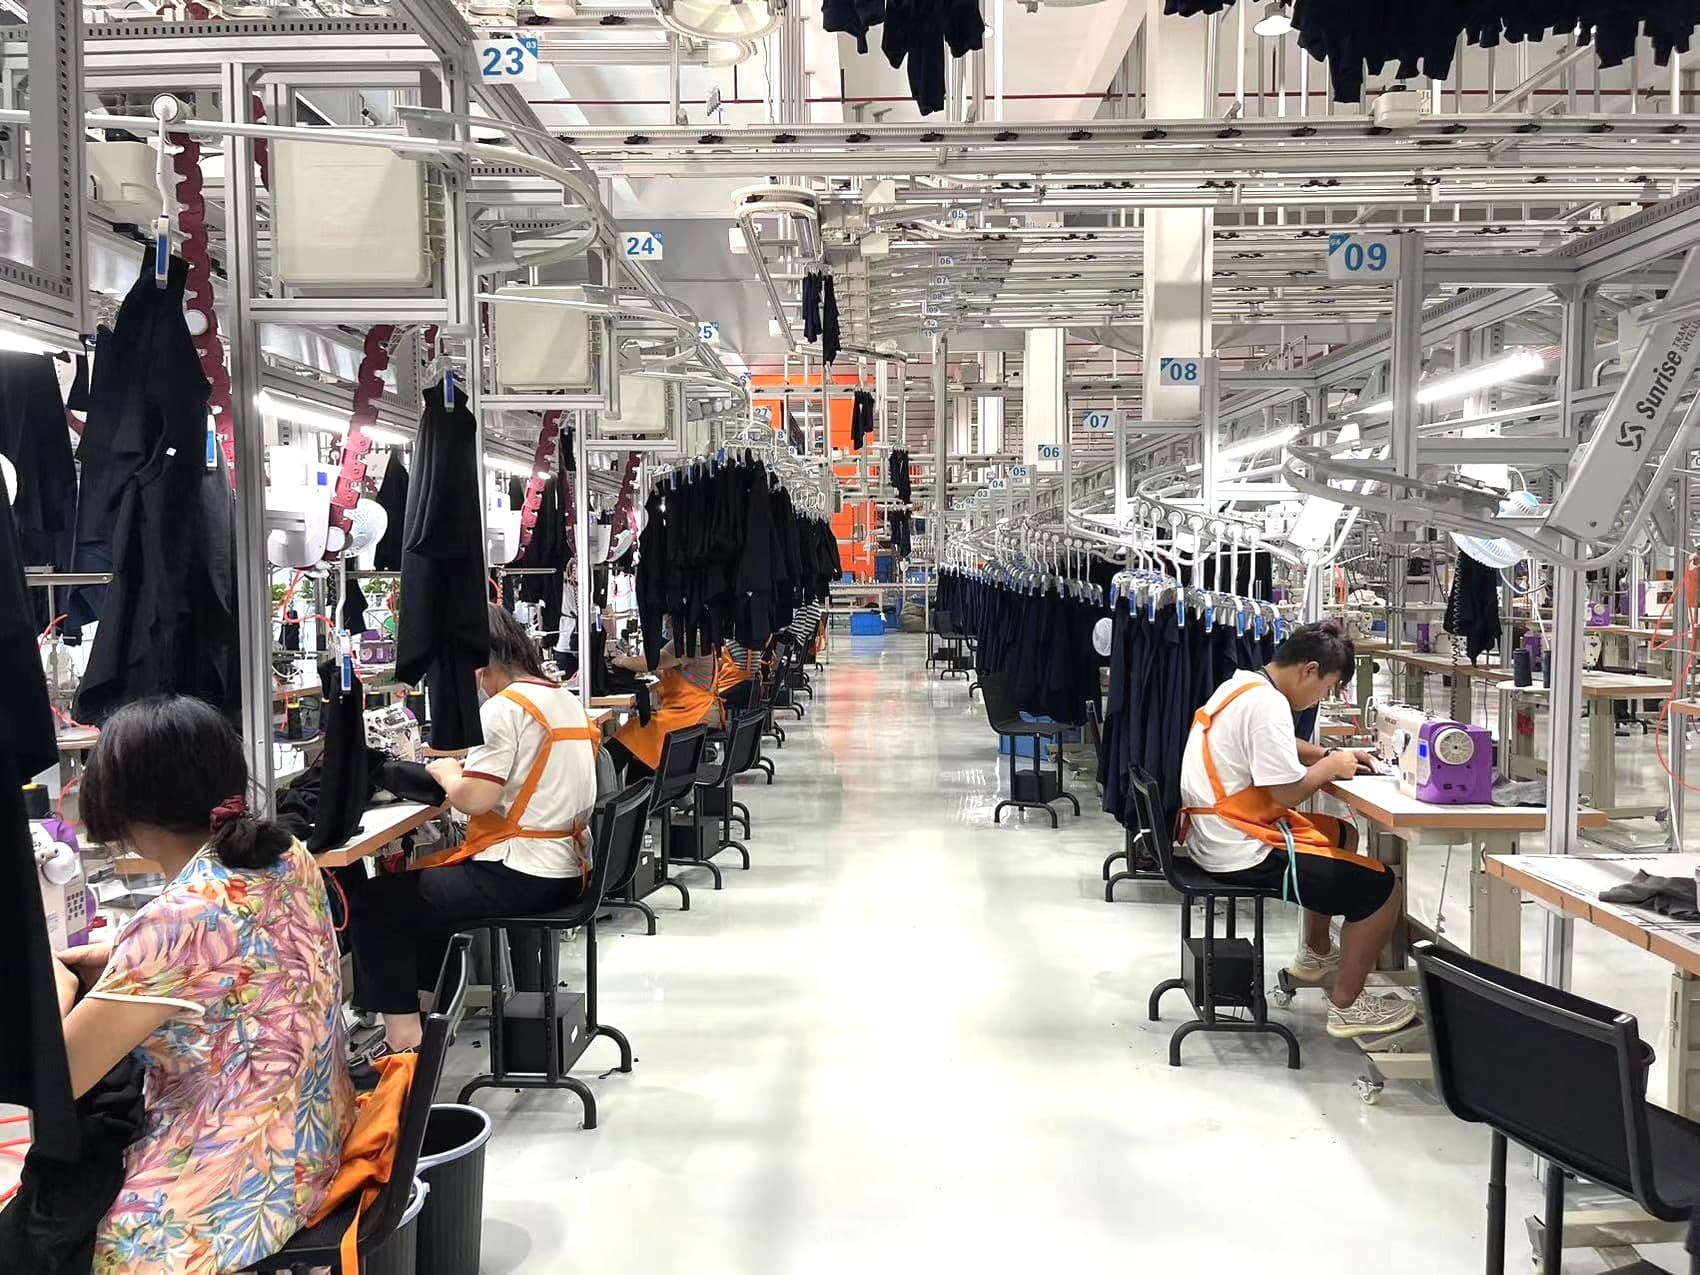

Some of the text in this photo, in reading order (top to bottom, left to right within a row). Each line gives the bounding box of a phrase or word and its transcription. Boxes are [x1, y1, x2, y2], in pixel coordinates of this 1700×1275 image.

[483, 46, 524, 76] 23
[952, 210, 964, 219] 05
[627, 236, 655, 255] 24
[940, 257, 951, 265] 06
[1344, 242, 1387, 271] 09
[936, 276, 946, 284] 07
[1170, 362, 1197, 381] 08
[1636, 350, 1682, 420] Sunrise
[1090, 415, 1109, 428] 07
[1043, 447, 1060, 458] 06
[1012, 466, 1026, 477] 05
[992, 480, 1004, 488] 04
[977, 490, 988, 498] 03
